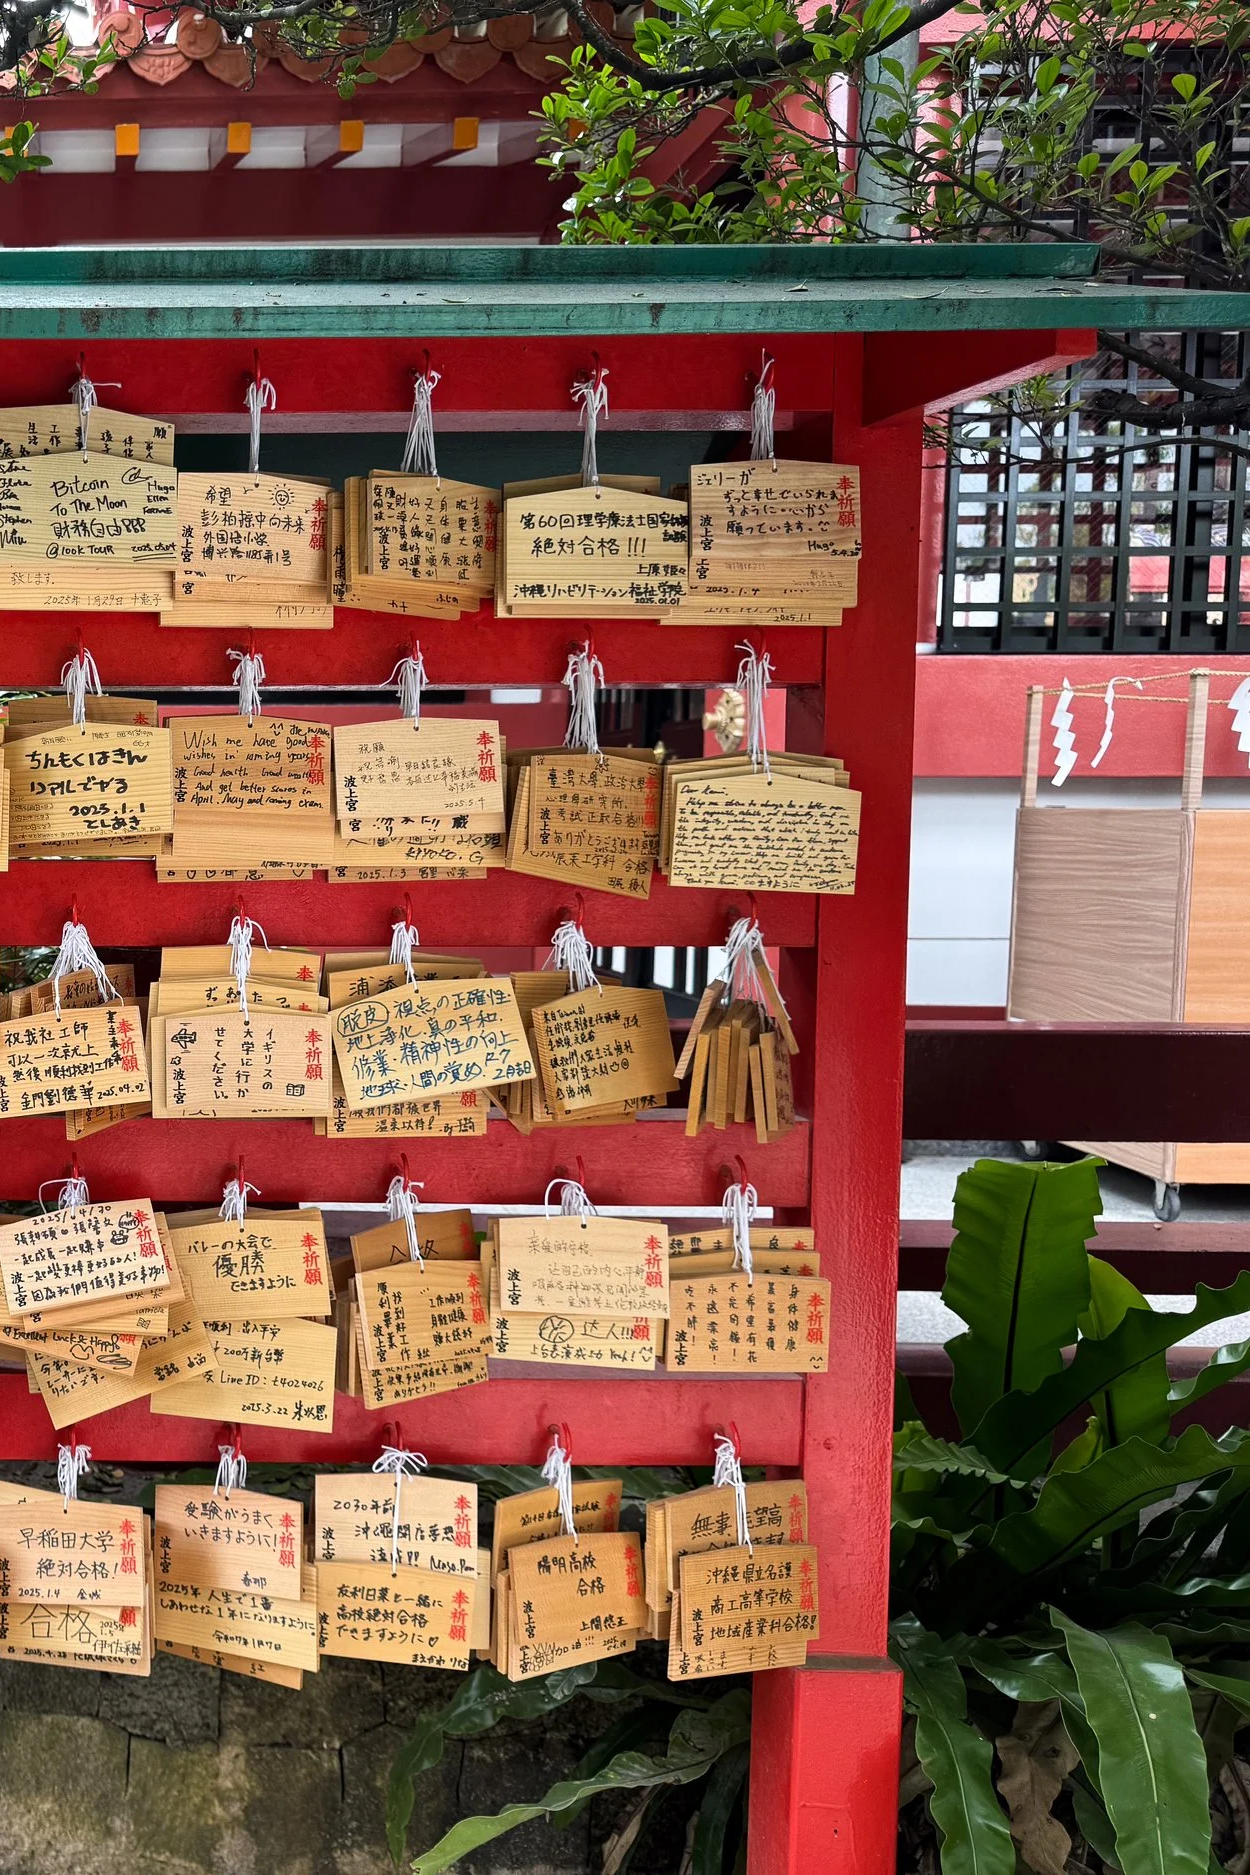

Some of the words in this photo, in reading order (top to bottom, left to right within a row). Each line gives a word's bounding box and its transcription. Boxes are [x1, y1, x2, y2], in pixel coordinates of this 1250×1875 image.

[49, 424, 61, 448] 工作
[50, 476, 109, 498] Bitcoin
[697, 467, 756, 487] ジェリーが
[50, 502, 67, 516] To
[70, 496, 95, 513] The
[97, 495, 128, 512] Moon
[205, 485, 232, 506] 希望
[836, 475, 856, 528] 奉祈願
[50, 518, 146, 539] 財務自由888
[309, 497, 328, 550] 奉祈願
[484, 499, 497, 552] 奉祈願
[699, 514, 713, 552] 波上宮
[88, 545, 115, 555] TOUR
[181, 525, 194, 562] 波上宮
[379, 531, 390, 570] 波上宮
[808, 539, 834, 553] Hugo
[636, 563, 660, 576] 上原
[184, 730, 217, 749] Wish
[226, 738, 242, 746] me
[286, 736, 310, 749] good
[184, 750, 215, 760] wishes
[477, 731, 497, 783] 奉祈願
[194, 763, 215, 777] Good
[307, 734, 325, 785] 奉祈願
[175, 768, 187, 803] 波上宮
[195, 783, 213, 792] And
[219, 783, 232, 794] get
[240, 783, 266, 793] better
[344, 776, 358, 811] 波上宮
[540, 808, 550, 844] 波上宮
[340, 1006, 378, 1032] 脱皮
[117, 1019, 140, 1072] 奉祈願
[212, 1027, 229, 1100] せてください。
[236, 1028, 255, 1099] 大学に行か
[262, 1028, 275, 1090] イギリスの
[304, 1028, 323, 1080] 奉祈願
[172, 1068, 186, 1105] 波上宮
[333, 1097, 346, 1133] 波上宮
[211, 1251, 266, 1278] 優勝
[301, 1233, 323, 1286] 奉祈願
[644, 1235, 663, 1288] 奉祈願
[11, 1271, 28, 1308] 波上宮
[230, 1276, 297, 1293] できますように
[467, 1272, 486, 1324] 奉祈願
[507, 1269, 521, 1306] 波上宮
[495, 1318, 509, 1353] 波上宮
[785, 1284, 800, 1352] 身体健康
[807, 1292, 825, 1344] 奉祈願
[373, 1324, 386, 1363] 波上宮
[674, 1330, 688, 1366] 波上宮
[221, 1374, 244, 1385] Line
[185, 1502, 272, 1528] 受験がうまく
[454, 1496, 472, 1548] 奉祈願
[17, 1527, 115, 1553] 早稲田大学
[119, 1518, 136, 1575] 奉祈願
[160, 1537, 172, 1574] 波上宮
[185, 1526, 277, 1553] いきますように!
[279, 1513, 296, 1568] 奉祈願
[0, 1558, 11, 1598] 波上宮
[36, 1557, 119, 1580] 絶対合格!
[538, 1553, 597, 1575] 陽明高校
[623, 1545, 641, 1597] 奉祈願
[705, 1562, 792, 1585] 沖縄県立名護
[18, 1587, 61, 1598] 2025.1.4
[159, 1581, 201, 1597] 2025年
[576, 1577, 606, 1596] 合格
[710, 1589, 793, 1616] 商工高等学校
[799, 1559, 814, 1612] 奉祈願
[21, 1603, 98, 1645] 合格
[318, 1612, 330, 1648] 波上宮
[337, 1609, 429, 1628] 高校絶対合格
[448, 1590, 469, 1641] 奉祈願
[522, 1600, 536, 1639] 波上宮
[692, 1608, 703, 1647] 波上宮
[337, 1625, 424, 1644] できますように
